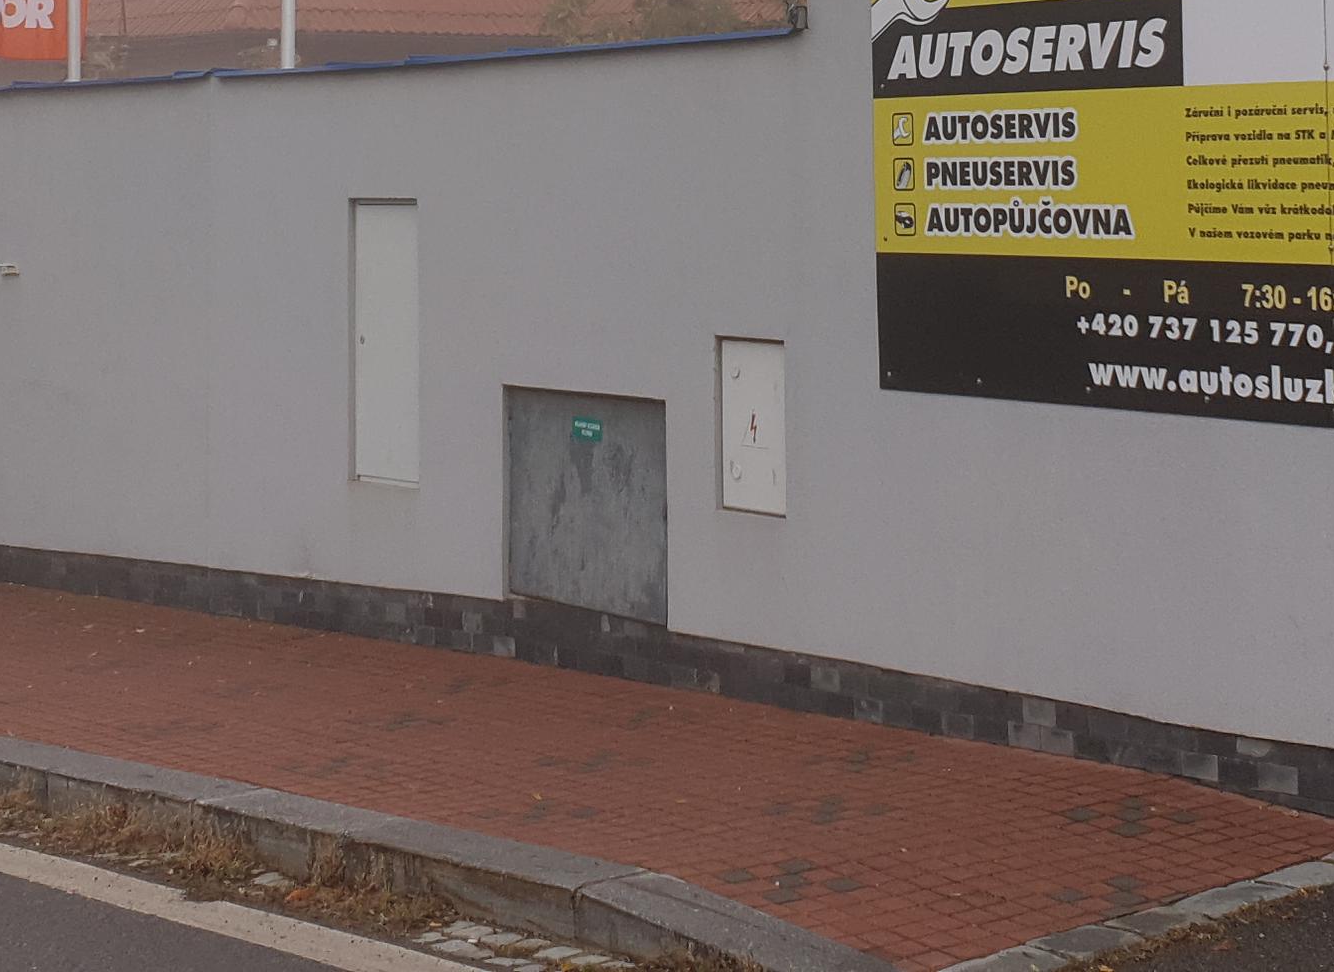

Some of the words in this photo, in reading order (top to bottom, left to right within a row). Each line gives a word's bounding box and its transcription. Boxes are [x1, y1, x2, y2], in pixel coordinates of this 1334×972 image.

[887, 17, 1168, 80] AUTOSERVIS
[1185, 105, 1224, 119] Záruční
[1227, 105, 1231, 117] i
[1235, 105, 1287, 119] pozáruční
[924, 111, 1076, 142] AUTOSERVIS
[1234, 129, 1274, 140] vozidla
[1277, 131, 1291, 140] na
[1295, 129, 1315, 140] STK
[1319, 131, 1326, 140] a
[1186, 155, 1227, 166] Celkové
[925, 159, 1076, 187] PNEUSERVIS
[1187, 180, 1244, 192] Ekologická
[1247, 180, 1297, 190] likvidace
[926, 199, 1134, 236] AUTOPŮJČOVNA
[1231, 204, 1254, 214] Vám
[1188, 228, 1196, 238] V
[1199, 228, 1233, 238] našem
[1236, 230, 1285, 240] vozovém
[1288, 230, 1320, 242] parku
[1065, 276, 1091, 299] Po
[1163, 280, 1189, 305] Pá
[1241, 283, 1286, 309] 7:30
[1077, 313, 1139, 337] +420
[1148, 316, 1197, 340] 737
[1210, 320, 1259, 344] 125
[1270, 322, 1334, 354] 770,
